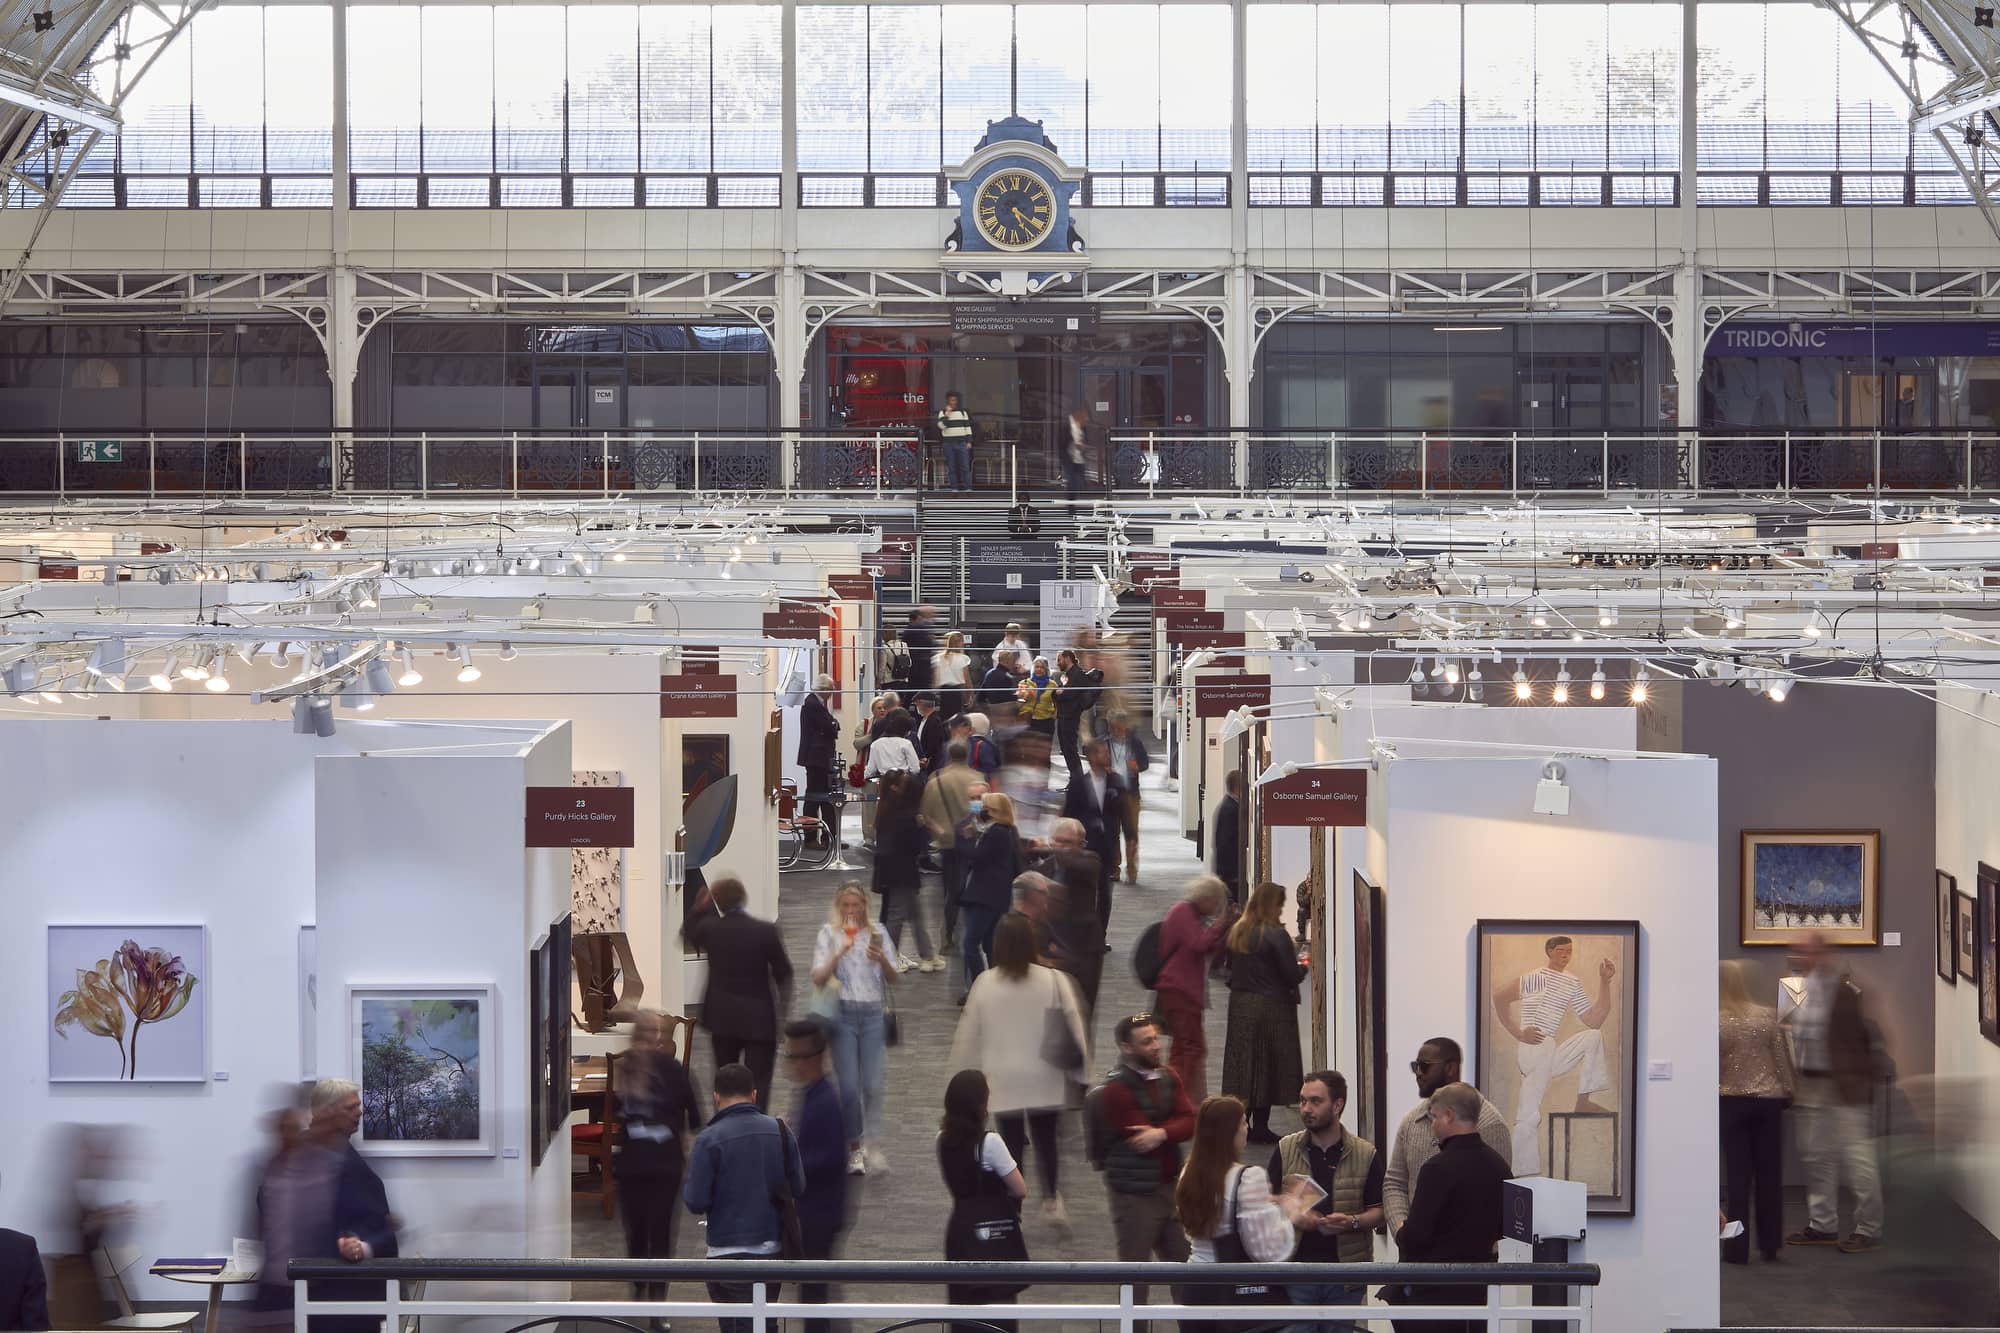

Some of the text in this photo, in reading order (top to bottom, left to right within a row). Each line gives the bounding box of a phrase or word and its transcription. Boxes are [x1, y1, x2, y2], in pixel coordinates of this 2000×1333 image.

[1724, 330, 1827, 347] TRIDONIC
[903, 393, 925, 404] the
[1062, 585, 1074, 598] H
[1311, 780, 1320, 788] 34
[1273, 792, 1359, 801] Osborne Samuel Gallery
[576, 800, 586, 808] 23
[544, 812, 617, 822] Purdy Hicks Gallery
